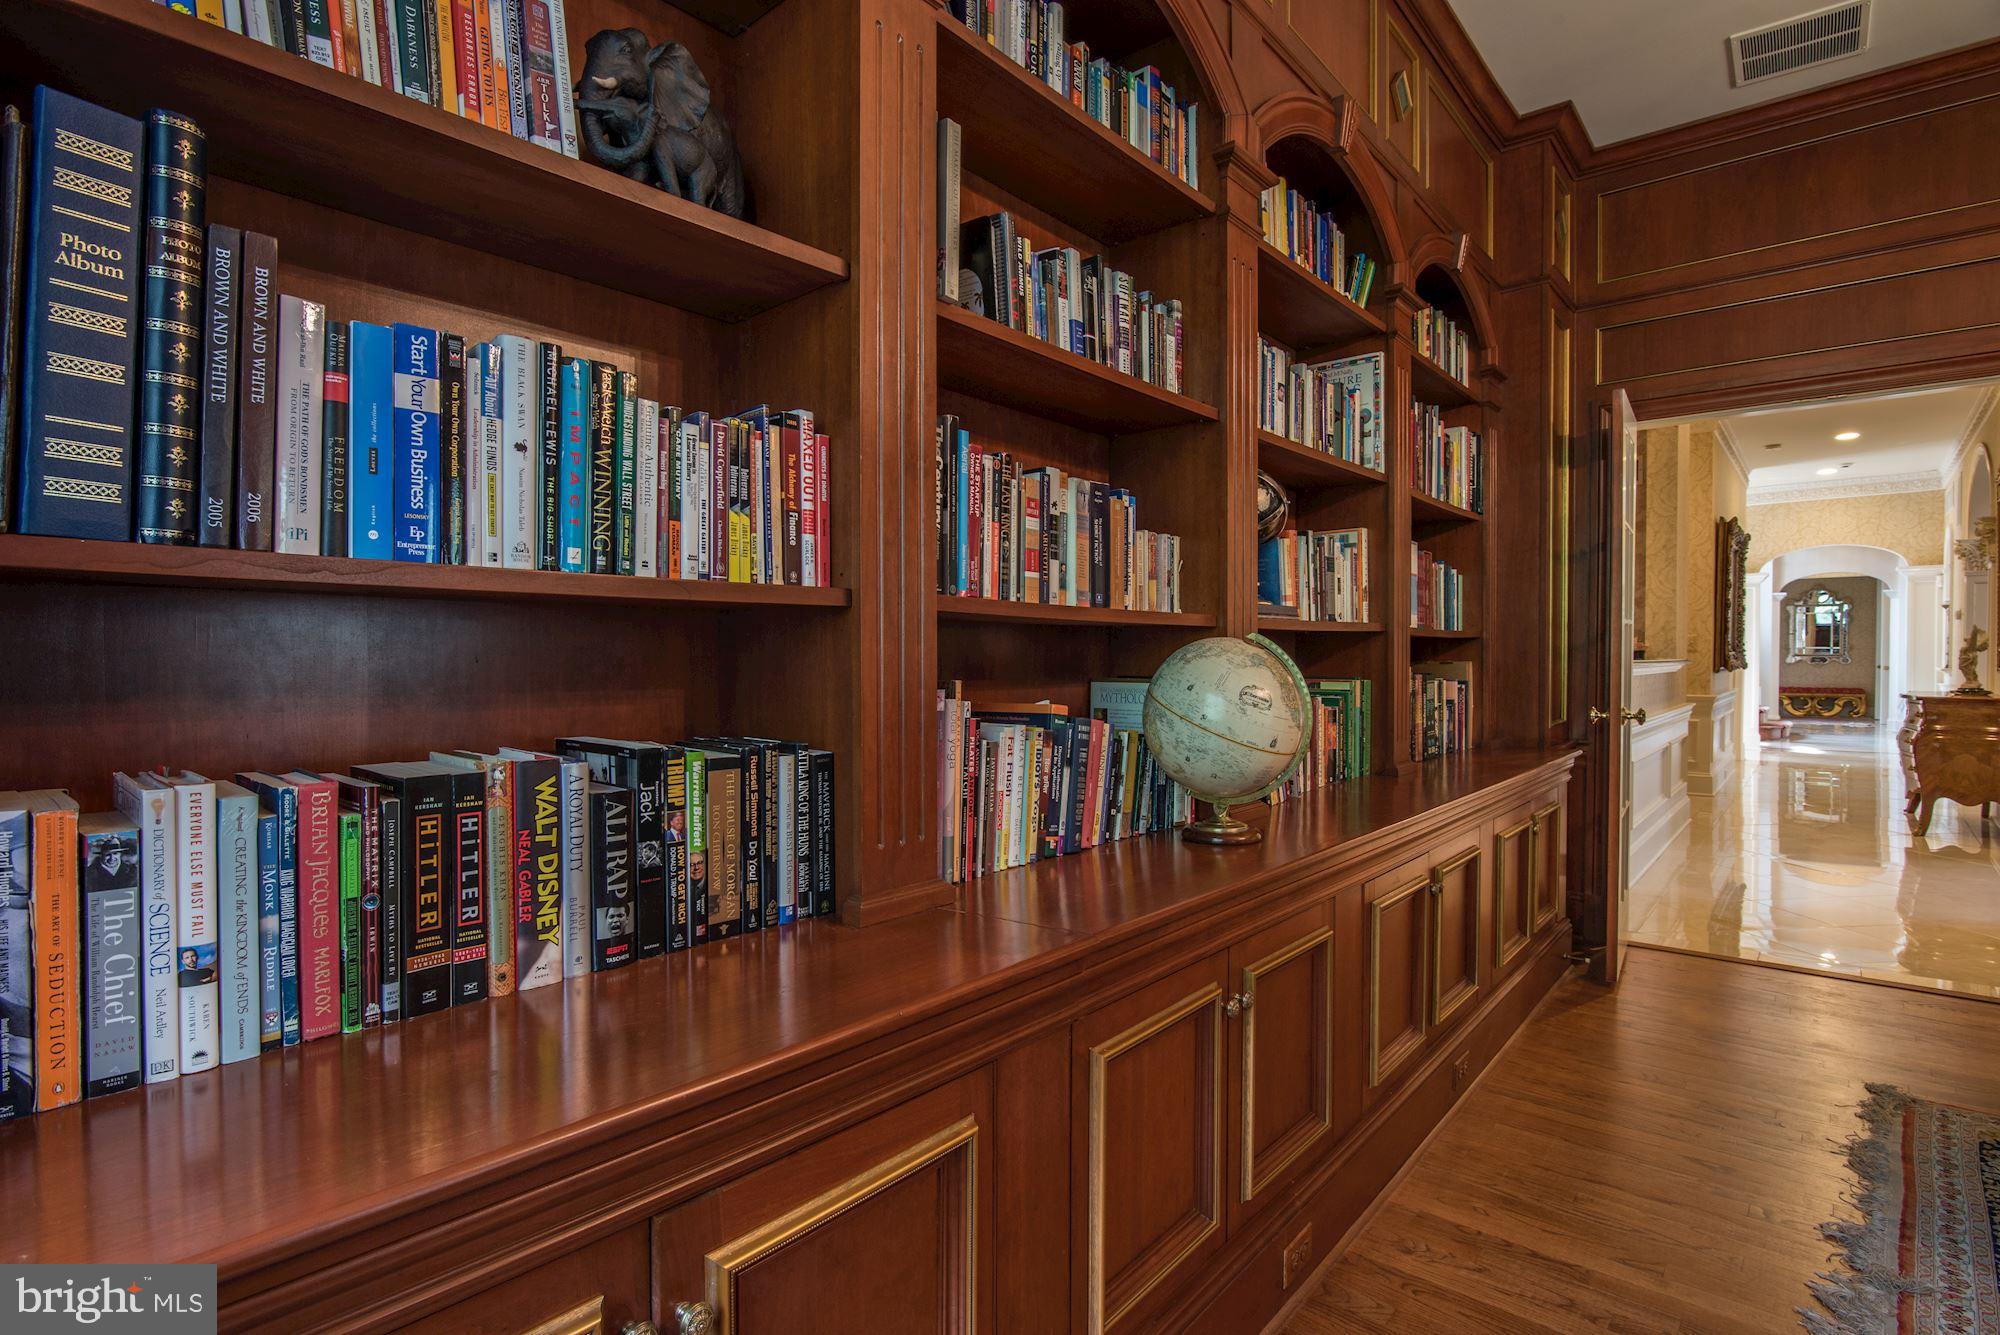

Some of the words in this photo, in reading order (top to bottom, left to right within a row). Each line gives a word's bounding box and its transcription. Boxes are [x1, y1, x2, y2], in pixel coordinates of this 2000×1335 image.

[405, 5, 419, 69] DARKNESS
[464, 13, 475, 69] DESCARTES'
[480, 26, 492, 70] GETTING
[556, 15, 567, 65] INNOVATIVE
[468, 74, 477, 106] ERROR
[484, 73, 492, 87] TO
[560, 66, 571, 114] ENTERPRISE
[484, 87, 494, 107] YES
[59, 231, 122, 261] Photo
[161, 235, 202, 255] PHOTO
[54, 250, 125, 280] Album
[214, 247, 231, 307] BROWN
[254, 266, 269, 320] BROWN
[212, 309, 230, 345] AND
[252, 322, 267, 354] AND
[410, 335, 428, 375] Start
[516, 343, 526, 364] THE
[211, 349, 228, 403] WHITE
[251, 358, 266, 404] WHITE
[302, 382, 310, 399] THE
[516, 367, 526, 398] BLACK
[546, 350, 557, 413] MICHAEL
[290, 388, 298, 414] FROM
[411, 378, 427, 411] Your
[302, 401, 311, 421] PATH
[516, 402, 526, 430] SWAN
[289, 416, 298, 449] ORIGIN
[301, 422, 310, 435] OF
[410, 412, 428, 447] Own
[546, 420, 557, 466] LEWIS
[622, 400, 634, 459] UNDERSTANDING
[717, 431, 725, 457] David
[334, 437, 345, 513] FREEDOM
[621, 460, 633, 480] WALL
[961, 445, 969, 474] Aerial
[1002, 464, 1011, 484] THE
[288, 466, 297, 504] RETURN
[300, 466, 309, 514] BONDSMEN
[410, 449, 428, 509] Business
[518, 468, 526, 489] Nassim
[546, 476, 555, 493] THE
[716, 458, 725, 510] Copperfield
[730, 465, 739, 498] Deliverance
[208, 496, 224, 528] 2005
[247, 492, 262, 523] 2006
[518, 490, 526, 514] Nicholas
[546, 495, 555, 509] BIG
[593, 448, 612, 552] WINNING
[621, 482, 633, 510] STREET
[1001, 486, 1010, 511] LAST
[518, 516, 526, 532] Taleb
[546, 515, 555, 545] SHORT
[623, 515, 631, 529] Little
[788, 512, 798, 546] Finance
[1000, 512, 1010, 539] KING
[397, 541, 436, 549] Entrepreneur
[623, 537, 631, 556] Rhodes
[730, 539, 738, 556] Dickey
[741, 540, 749, 558] Dickey
[1100, 693, 1146, 704] MYTHOLO
[947, 738, 957, 769] yoga
[1079, 747, 1088, 763] THE
[667, 757, 686, 807] TRUMP
[692, 760, 702, 805] Warren
[726, 771, 735, 796] THE
[1005, 762, 1013, 797] Flush
[1016, 775, 1024, 809] BELLY
[1054, 768, 1062, 802] Mathematics
[190, 792, 203, 846] EVERYONE
[534, 775, 558, 847] WALT
[640, 782, 655, 824] Jack
[712, 804, 721, 827] RON
[311, 790, 331, 855] BRIAN
[388, 819, 396, 848] JOSEPH
[692, 806, 702, 847] Buffett
[726, 800, 735, 841] HOUSE
[0, 831, 13, 869] Howard
[153, 829, 165, 893] DICTIONARY
[190, 851, 203, 877] ELSE
[518, 829, 532, 867] NEAL
[677, 845, 685, 867] HOW
[712, 830, 721, 890] CHERNOW
[726, 843, 735, 860] OF
[388, 850, 397, 889] CAMPBELL
[420, 819, 438, 927] HITLER
[461, 817, 480, 920] HITLER
[677, 868, 685, 882] TO
[0, 870, 13, 907] Hughes
[91, 898, 99, 911] The
[152, 893, 165, 901] of
[191, 882, 204, 910] MUST
[262, 868, 276, 910] MONK
[305, 857, 332, 939] JACQUES
[518, 870, 532, 923] GABLER
[536, 853, 560, 946] DISNEY
[677, 884, 686, 902] GET
[726, 863, 736, 919] MORGAN
[91, 912, 100, 929] Life
[103, 891, 135, 947] The
[191, 914, 204, 938] FAIL
[677, 903, 686, 925] RICH
[149, 903, 171, 977] SCIENCE
[417, 935, 441, 944] NATIONAL
[458, 929, 482, 937] NATIONAL
[91, 940, 100, 969] William
[263, 946, 278, 993] RIDDLE
[91, 971, 100, 1004] Randolph
[103, 953, 136, 1027] Chief
[313, 946, 332, 1017] MARLFOX
[49, 952, 66, 1071] SEDUCTION
[155, 987, 167, 1010] Neil
[91, 1006, 99, 1030] Hearst
[153, 1011, 168, 1039] Ardley
[103, 1076, 128, 1084] MARINER
[106, 1080, 124, 1088] BOOKS
